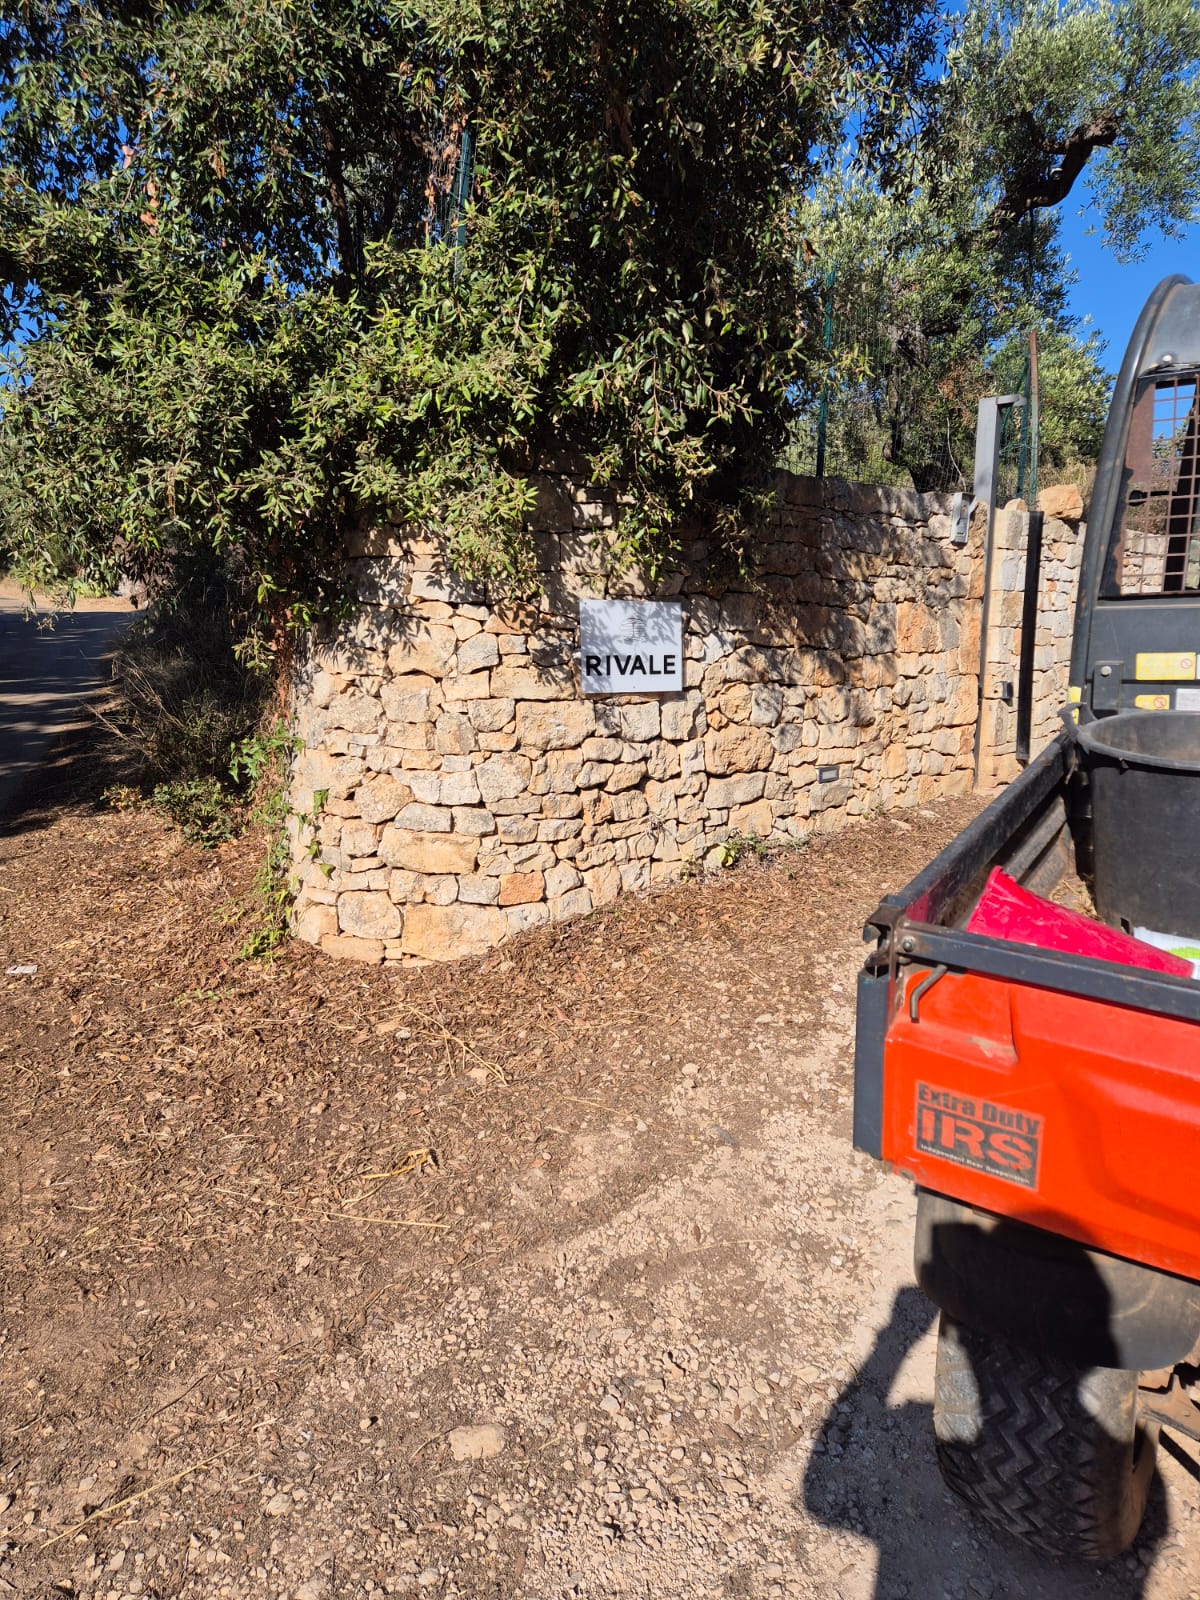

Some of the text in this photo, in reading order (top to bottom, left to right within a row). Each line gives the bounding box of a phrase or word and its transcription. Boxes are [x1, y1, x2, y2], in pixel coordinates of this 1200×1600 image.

[585, 654, 676, 676] RIVALE
[918, 1082, 1040, 1137] Extra Duty
[920, 1109, 1033, 1171] IRS
[920, 1143, 965, 1164] Independent
